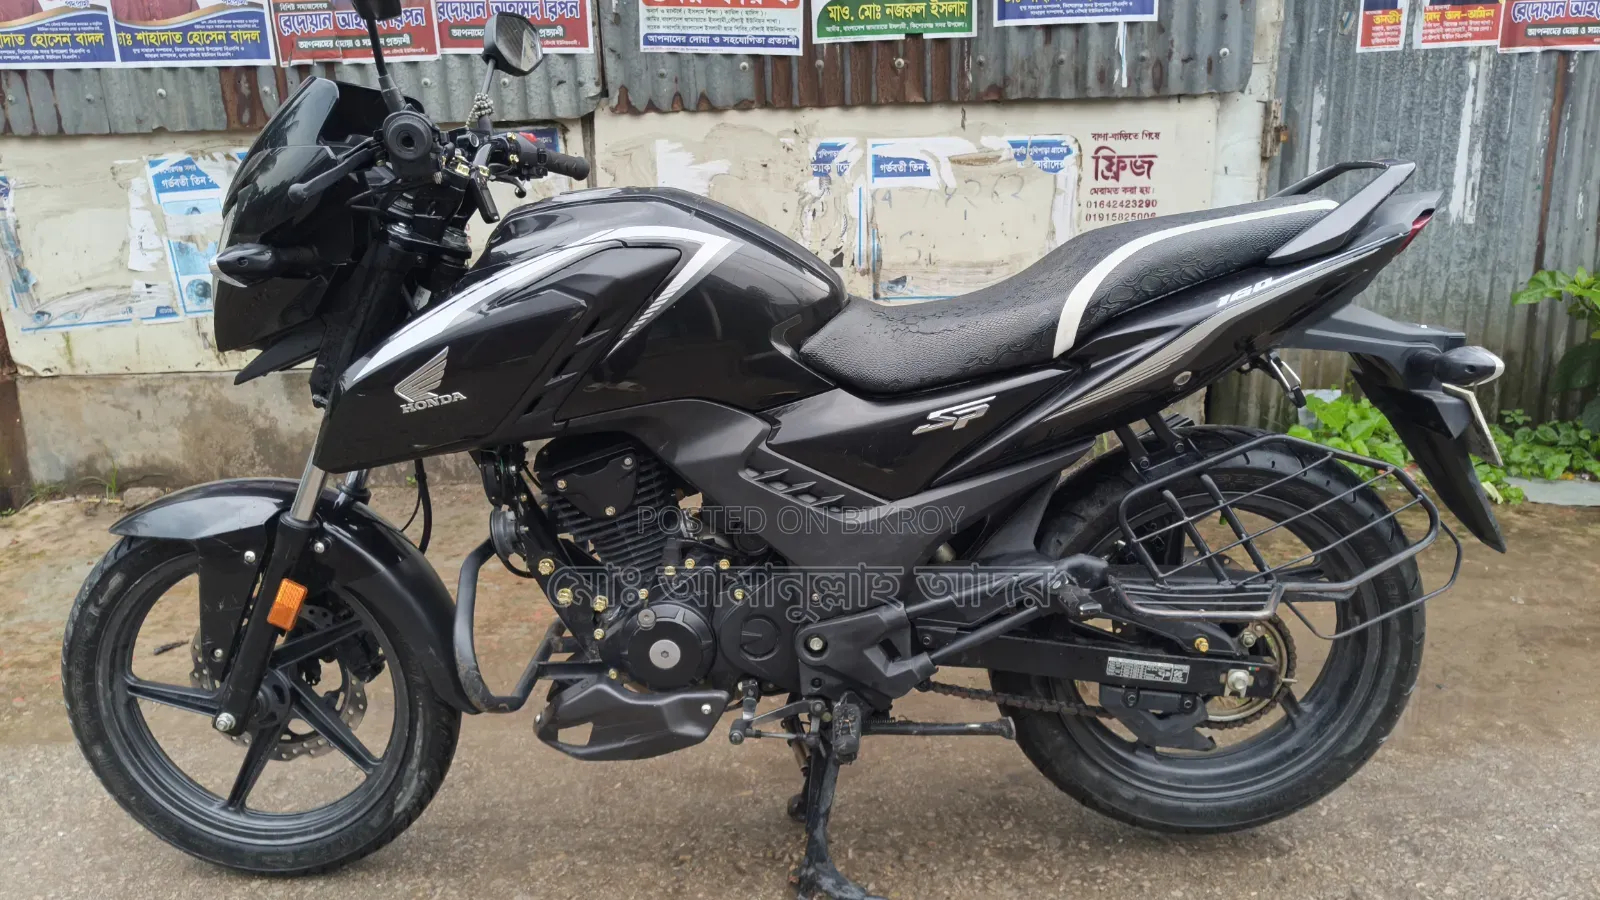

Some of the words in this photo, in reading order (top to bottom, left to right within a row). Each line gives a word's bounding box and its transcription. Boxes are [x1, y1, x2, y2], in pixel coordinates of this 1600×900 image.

[543, 0, 580, 21] রিপন
[827, 4, 854, 22] মাও.
[858, 2, 882, 20] মোঃ
[884, 3, 927, 19] নজরুল
[929, 0, 968, 18] ইসলাম
[1511, 0, 1568, 23] রেদোয়ান
[278, 12, 333, 36] রেদোয়ান
[451, 28, 485, 37] আপনাদে
[538, 25, 563, 37] প্রত্যাশী
[0, 33, 26, 48] াদাত
[31, 33, 72, 48] হোসেন
[74, 32, 105, 46] বাদল
[135, 30, 183, 46] শাহাদাত
[187, 29, 227, 45] হোসেন
[228, 29, 261, 44] বাদল
[386, 33, 411, 46] প্রত্যাশী
[647, 35, 687, 43] আপনাদের
[689, 35, 710, 44] দোয়া
[722, 35, 766, 45] সহযোগিতা
[767, 35, 798, 45] প্রত্যাশী
[880, 161, 907, 173] গর্ভবতী
[909, 161, 924, 172] তিন
[1091, 145, 1158, 182] ফ্রিজ
[161, 174, 188, 189] গর্ভবতী
[190, 173, 206, 185] তিন
[1090, 187, 1119, 195] মেরামত
[1121, 186, 1137, 194] করা
[1086, 200, 1158, 209] 01642423290
[400, 391, 467, 414] HONDA
[912, 395, 997, 435] SP
